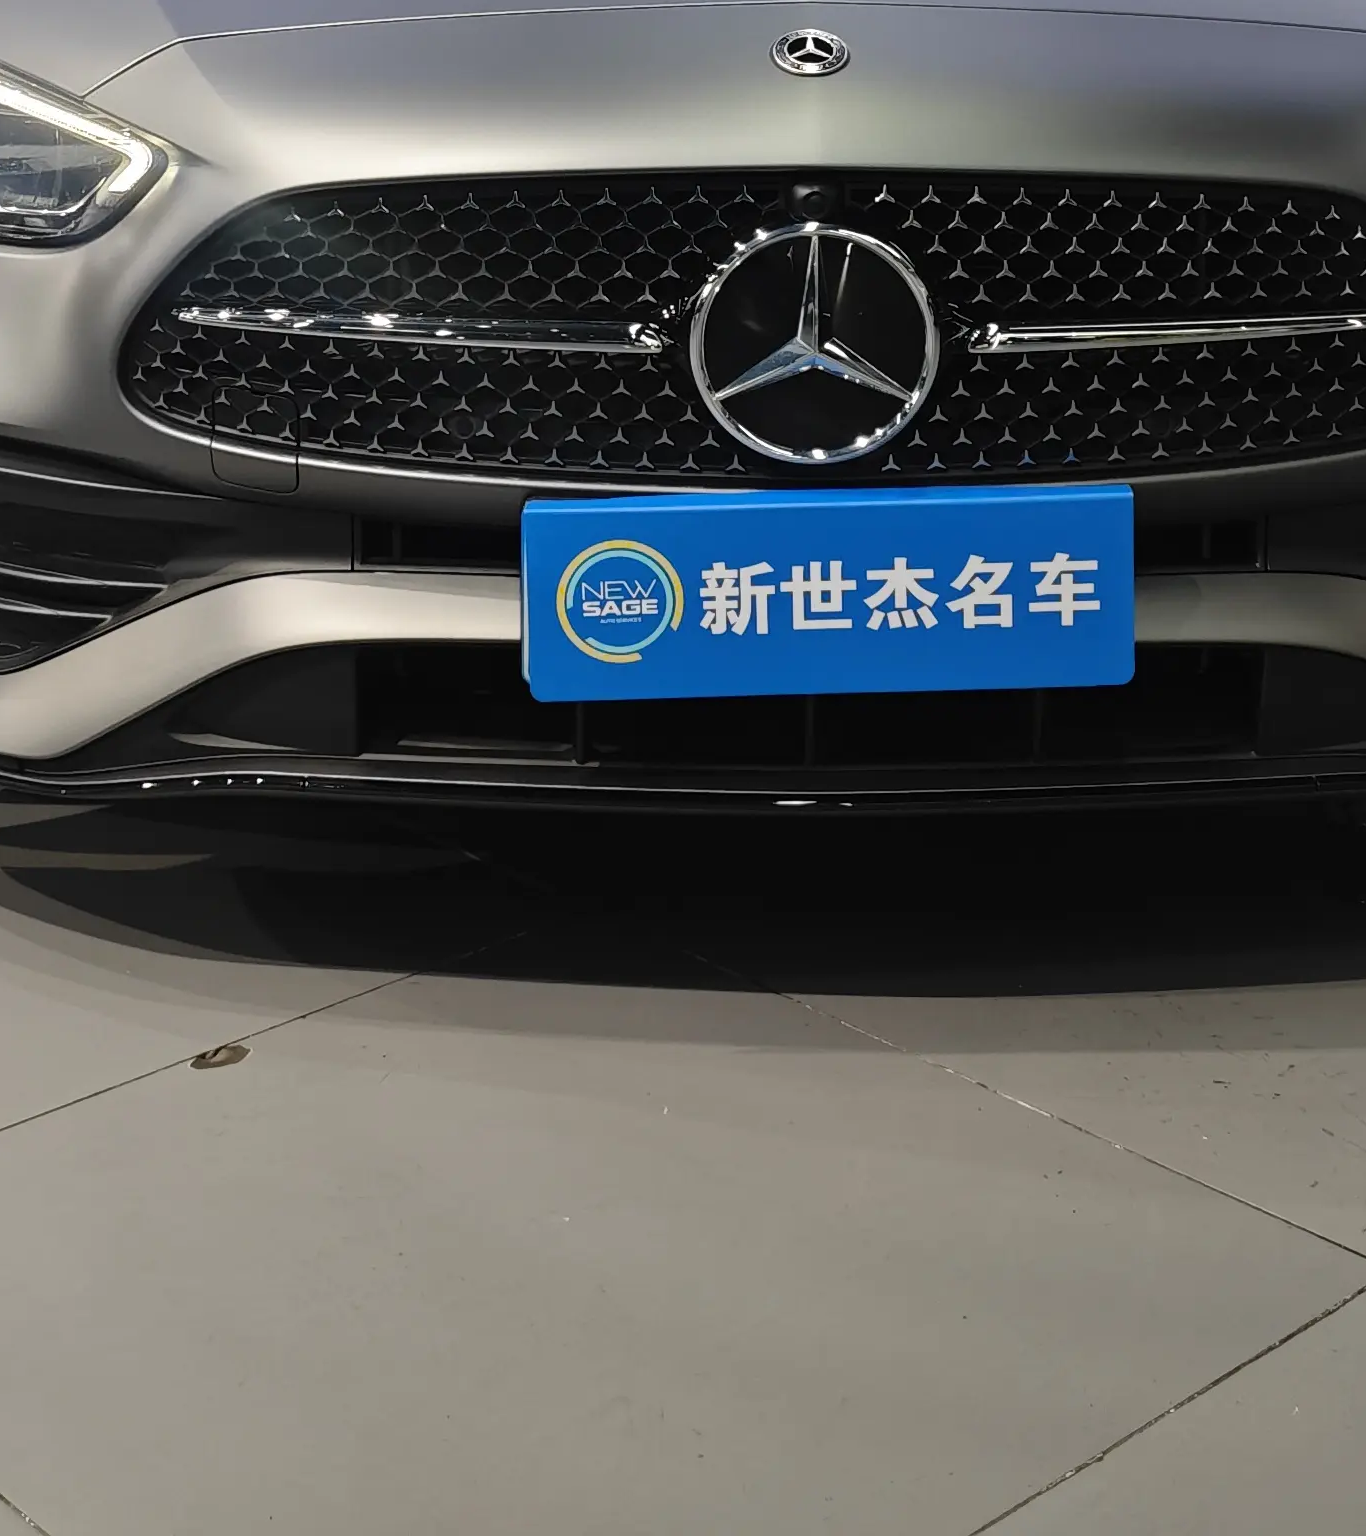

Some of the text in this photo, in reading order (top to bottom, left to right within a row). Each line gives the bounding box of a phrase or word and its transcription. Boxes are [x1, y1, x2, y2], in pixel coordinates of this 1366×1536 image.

[581, 579, 656, 600] NEW
[699, 552, 1102, 635] 新世杰名车
[582, 598, 659, 617] SAGE
